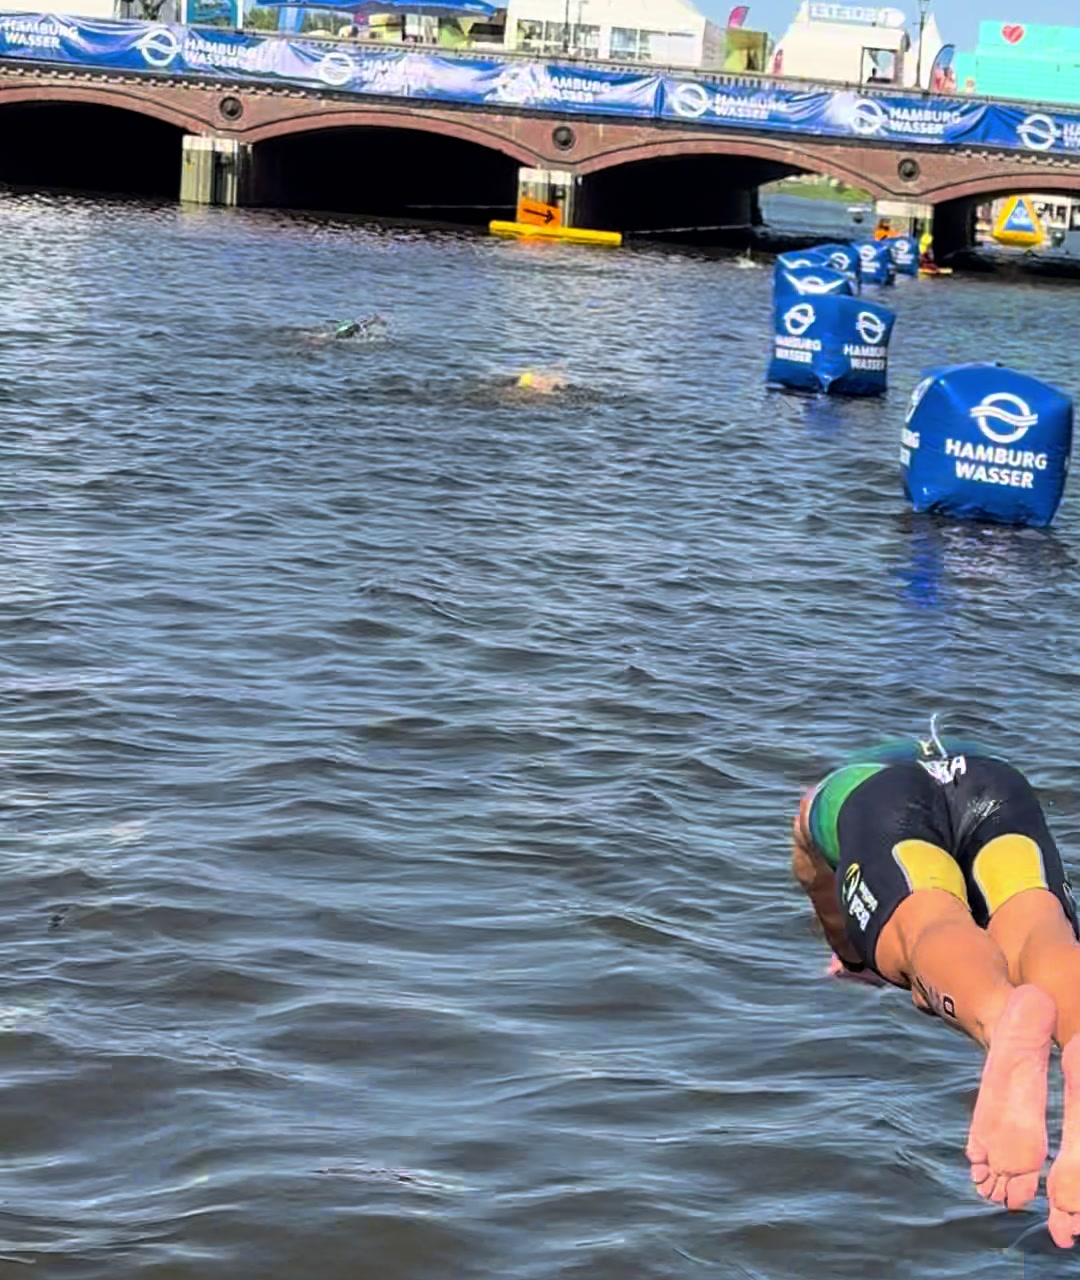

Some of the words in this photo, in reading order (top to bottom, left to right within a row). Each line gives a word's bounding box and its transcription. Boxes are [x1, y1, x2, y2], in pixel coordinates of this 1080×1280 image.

[4, 31, 62, 49] WASSER
[889, 107, 961, 124] HAMBURG
[889, 120, 944, 135] WASSER
[945, 438, 1048, 470] HAMBURG
[955, 460, 1034, 489] WASSER
